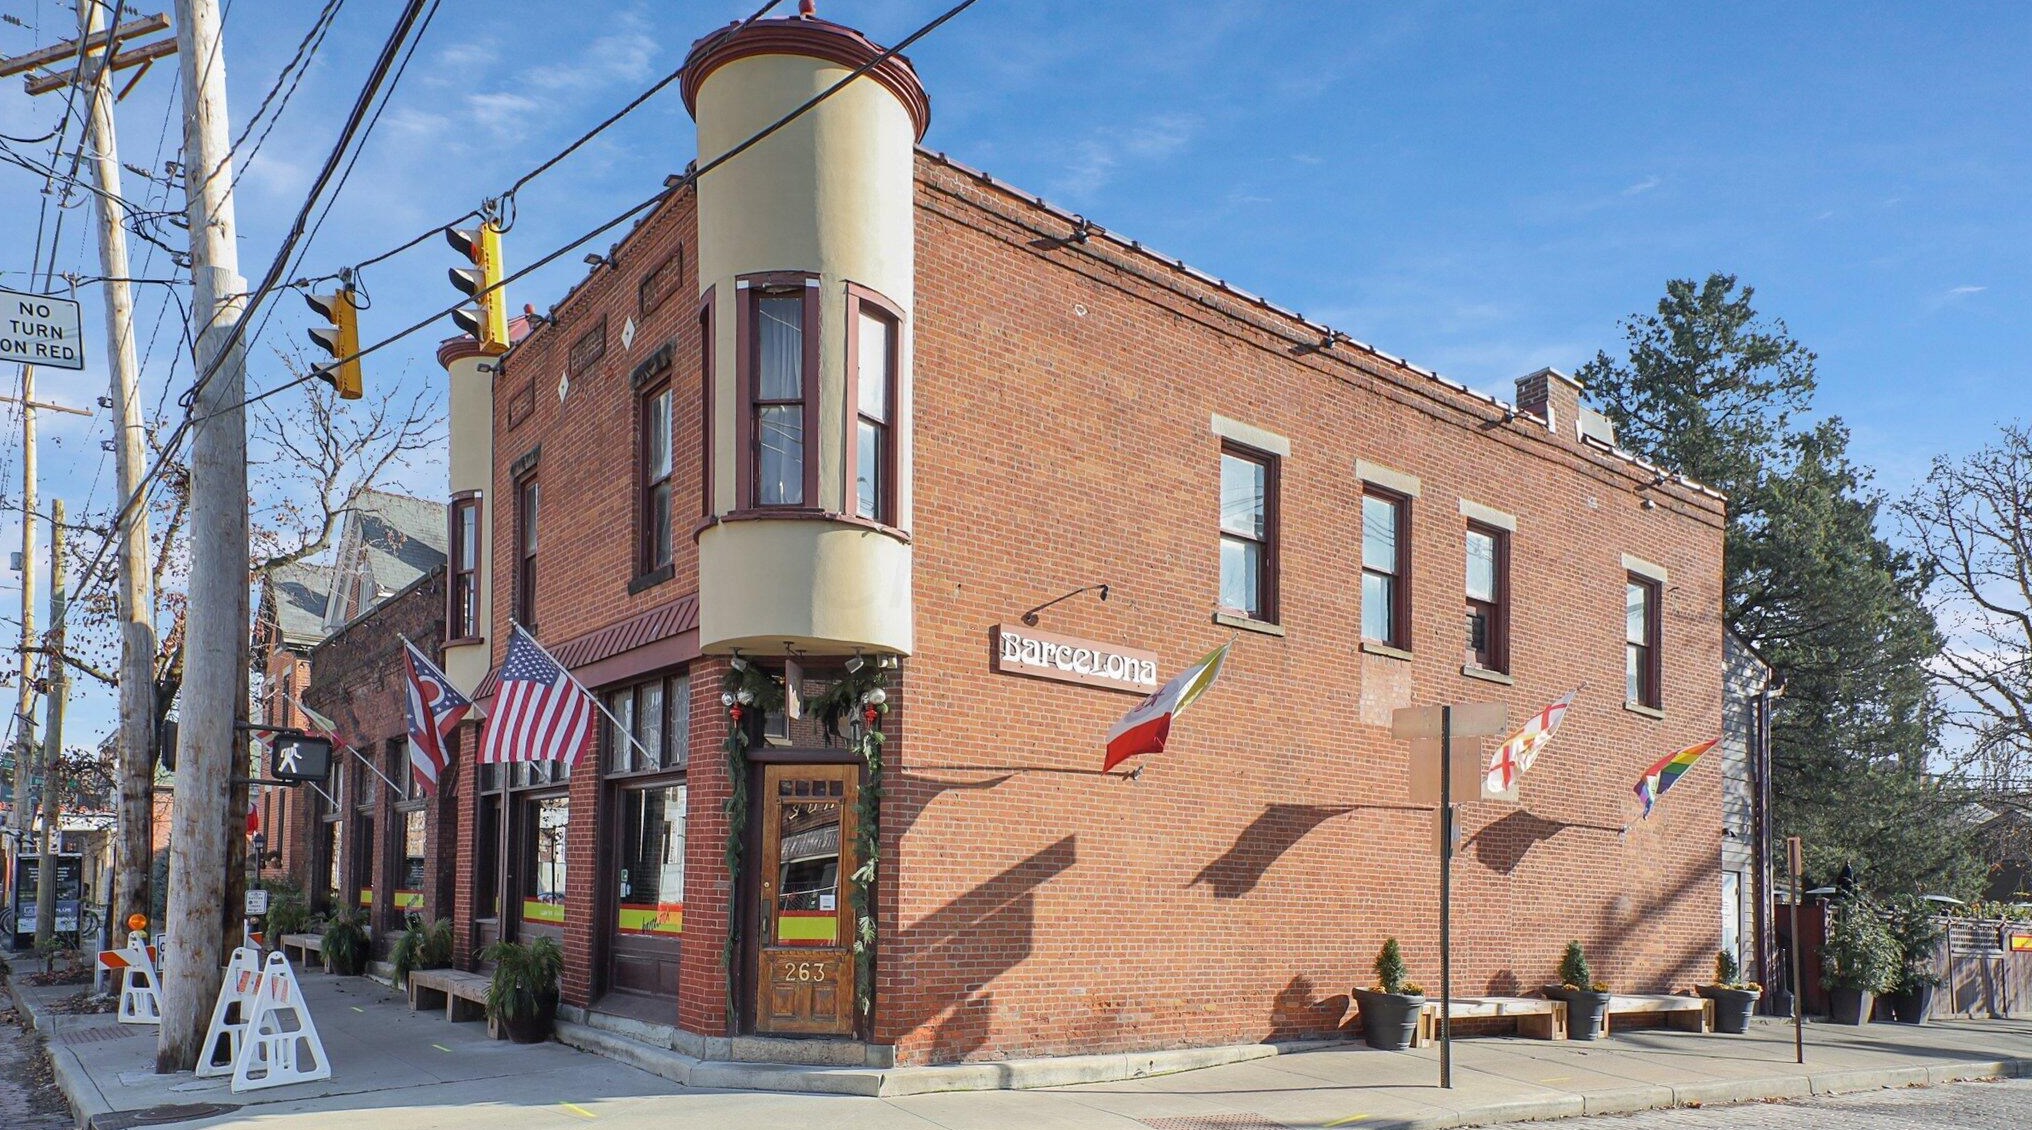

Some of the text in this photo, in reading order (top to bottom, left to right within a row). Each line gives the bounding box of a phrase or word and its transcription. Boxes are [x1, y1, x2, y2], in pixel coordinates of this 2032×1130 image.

[19, 301, 51, 318] NO
[9, 319, 63, 340] TURN
[0, 338, 75, 360] ON RED
[785, 962, 825, 982] 263
